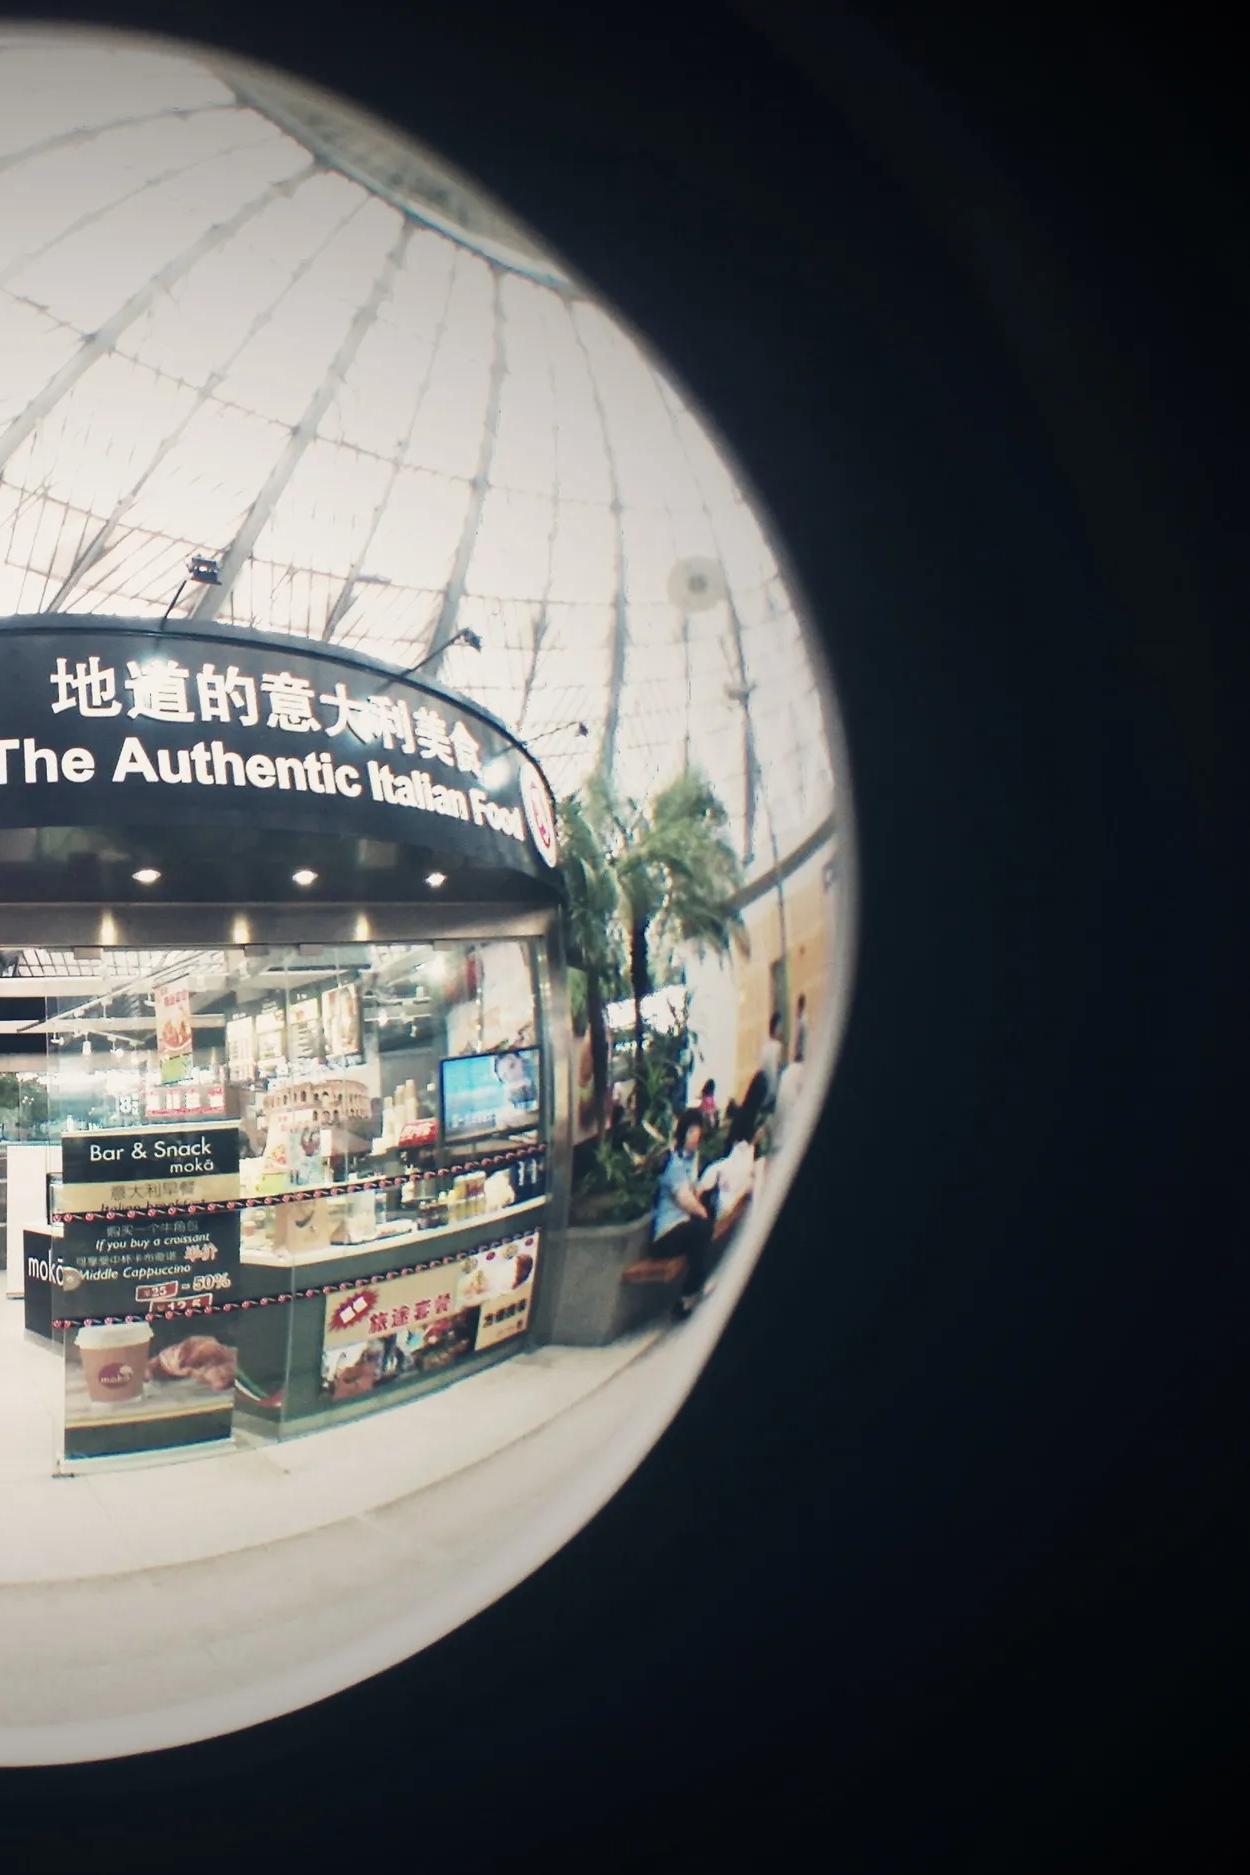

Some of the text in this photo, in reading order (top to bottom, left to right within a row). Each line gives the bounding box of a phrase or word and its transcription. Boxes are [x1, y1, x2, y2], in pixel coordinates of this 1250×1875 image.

[50, 656, 484, 780] 地道的意大利美食
[112, 737, 362, 797] Authentic
[367, 760, 469, 821] Italian
[469, 788, 526, 842] Food
[90, 1136, 211, 1161] Bar & Snack
[95, 1240, 104, 1252] If
[107, 1241, 126, 1251] you
[130, 1238, 150, 1250] buy
[164, 1233, 210, 1245] croissant
[80, 1264, 191, 1281] Middle Cappuccino
[369, 1292, 452, 1334] 旅途套餐
